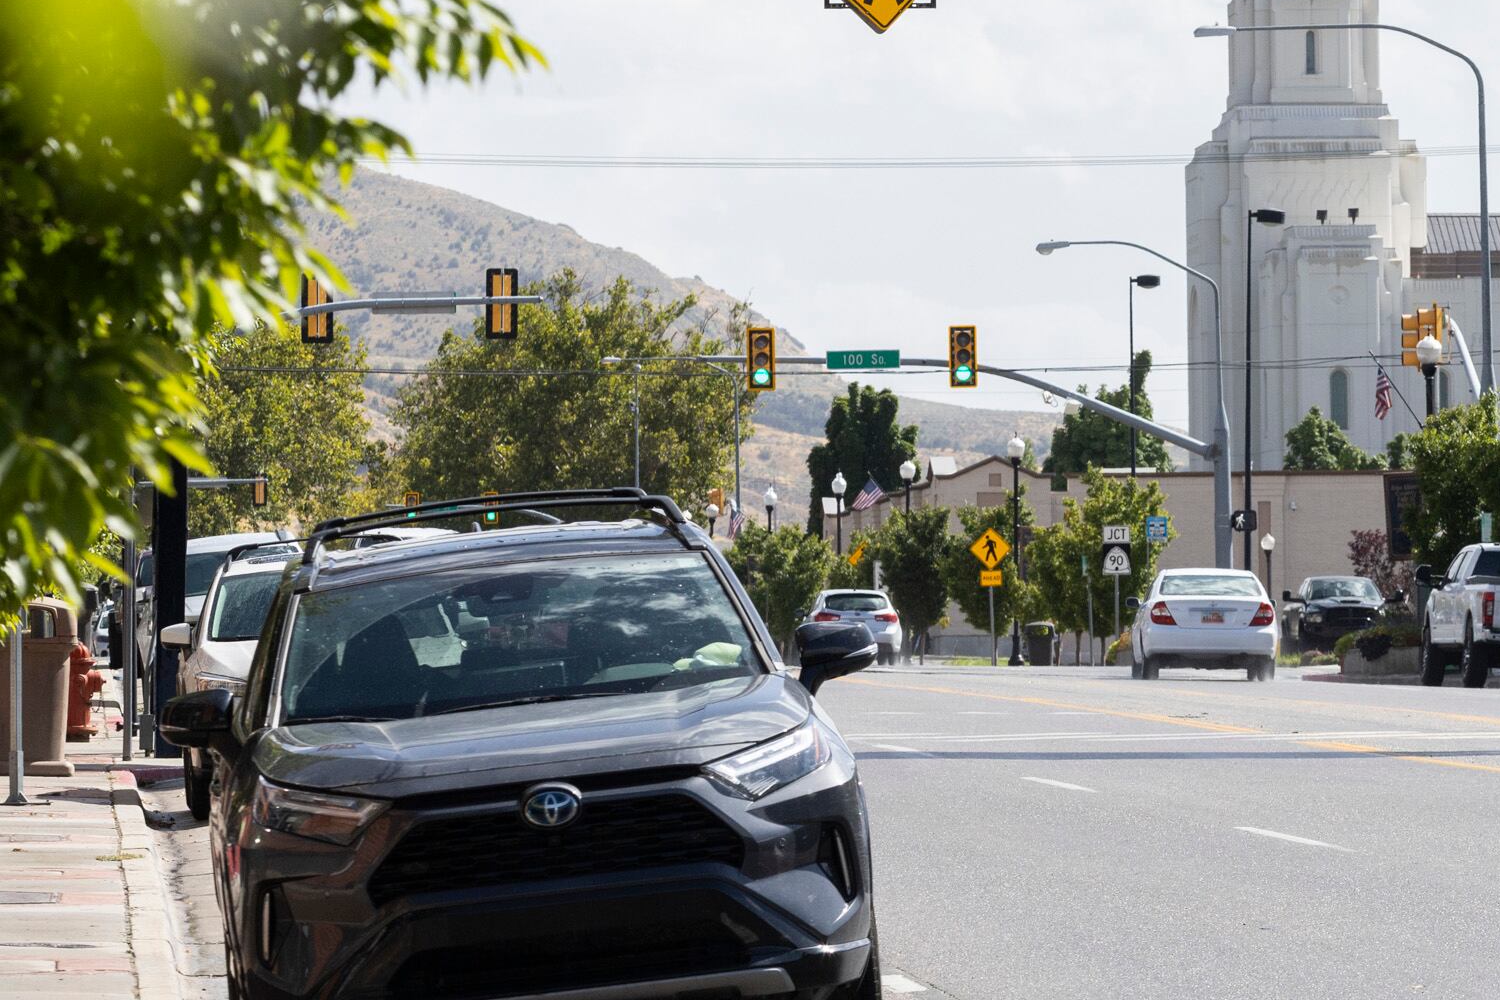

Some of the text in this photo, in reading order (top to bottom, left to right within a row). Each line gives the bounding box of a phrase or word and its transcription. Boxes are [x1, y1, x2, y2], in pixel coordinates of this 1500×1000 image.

[843, 354, 864, 366] 100
[1107, 528, 1126, 541] JCT
[1109, 555, 1124, 567] 90
